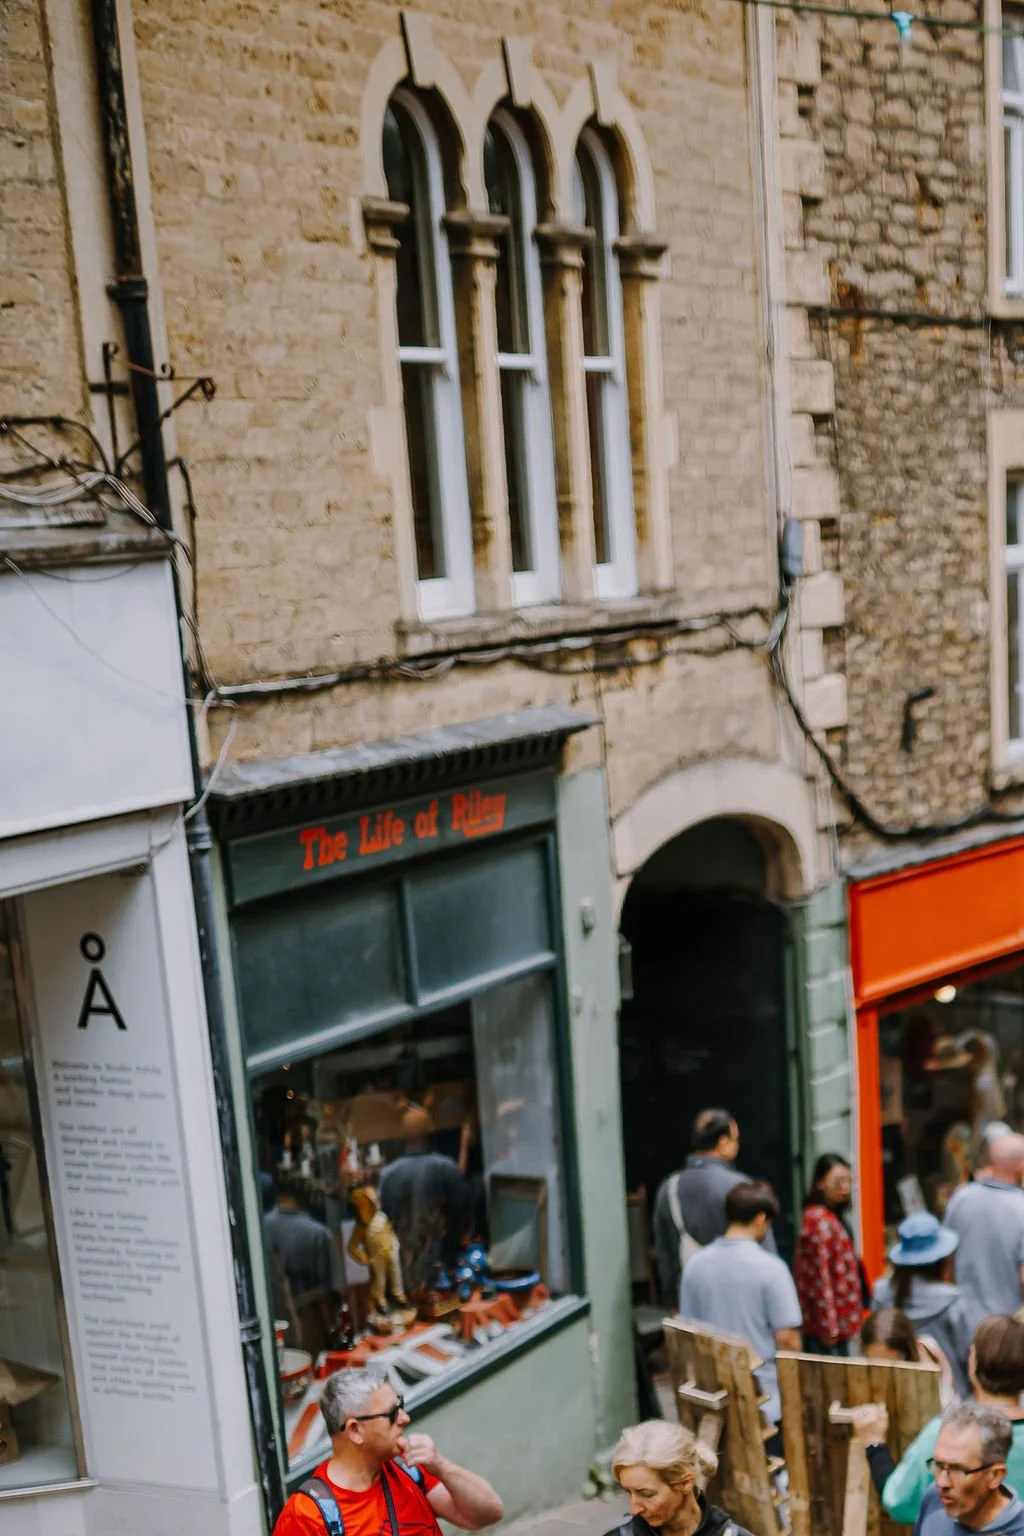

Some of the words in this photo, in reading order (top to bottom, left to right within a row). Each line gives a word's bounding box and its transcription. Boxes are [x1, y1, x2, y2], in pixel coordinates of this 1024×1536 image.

[299, 825, 348, 870] The
[359, 809, 405, 856] Life
[414, 799, 439, 840] of
[451, 787, 506, 838] Riley
